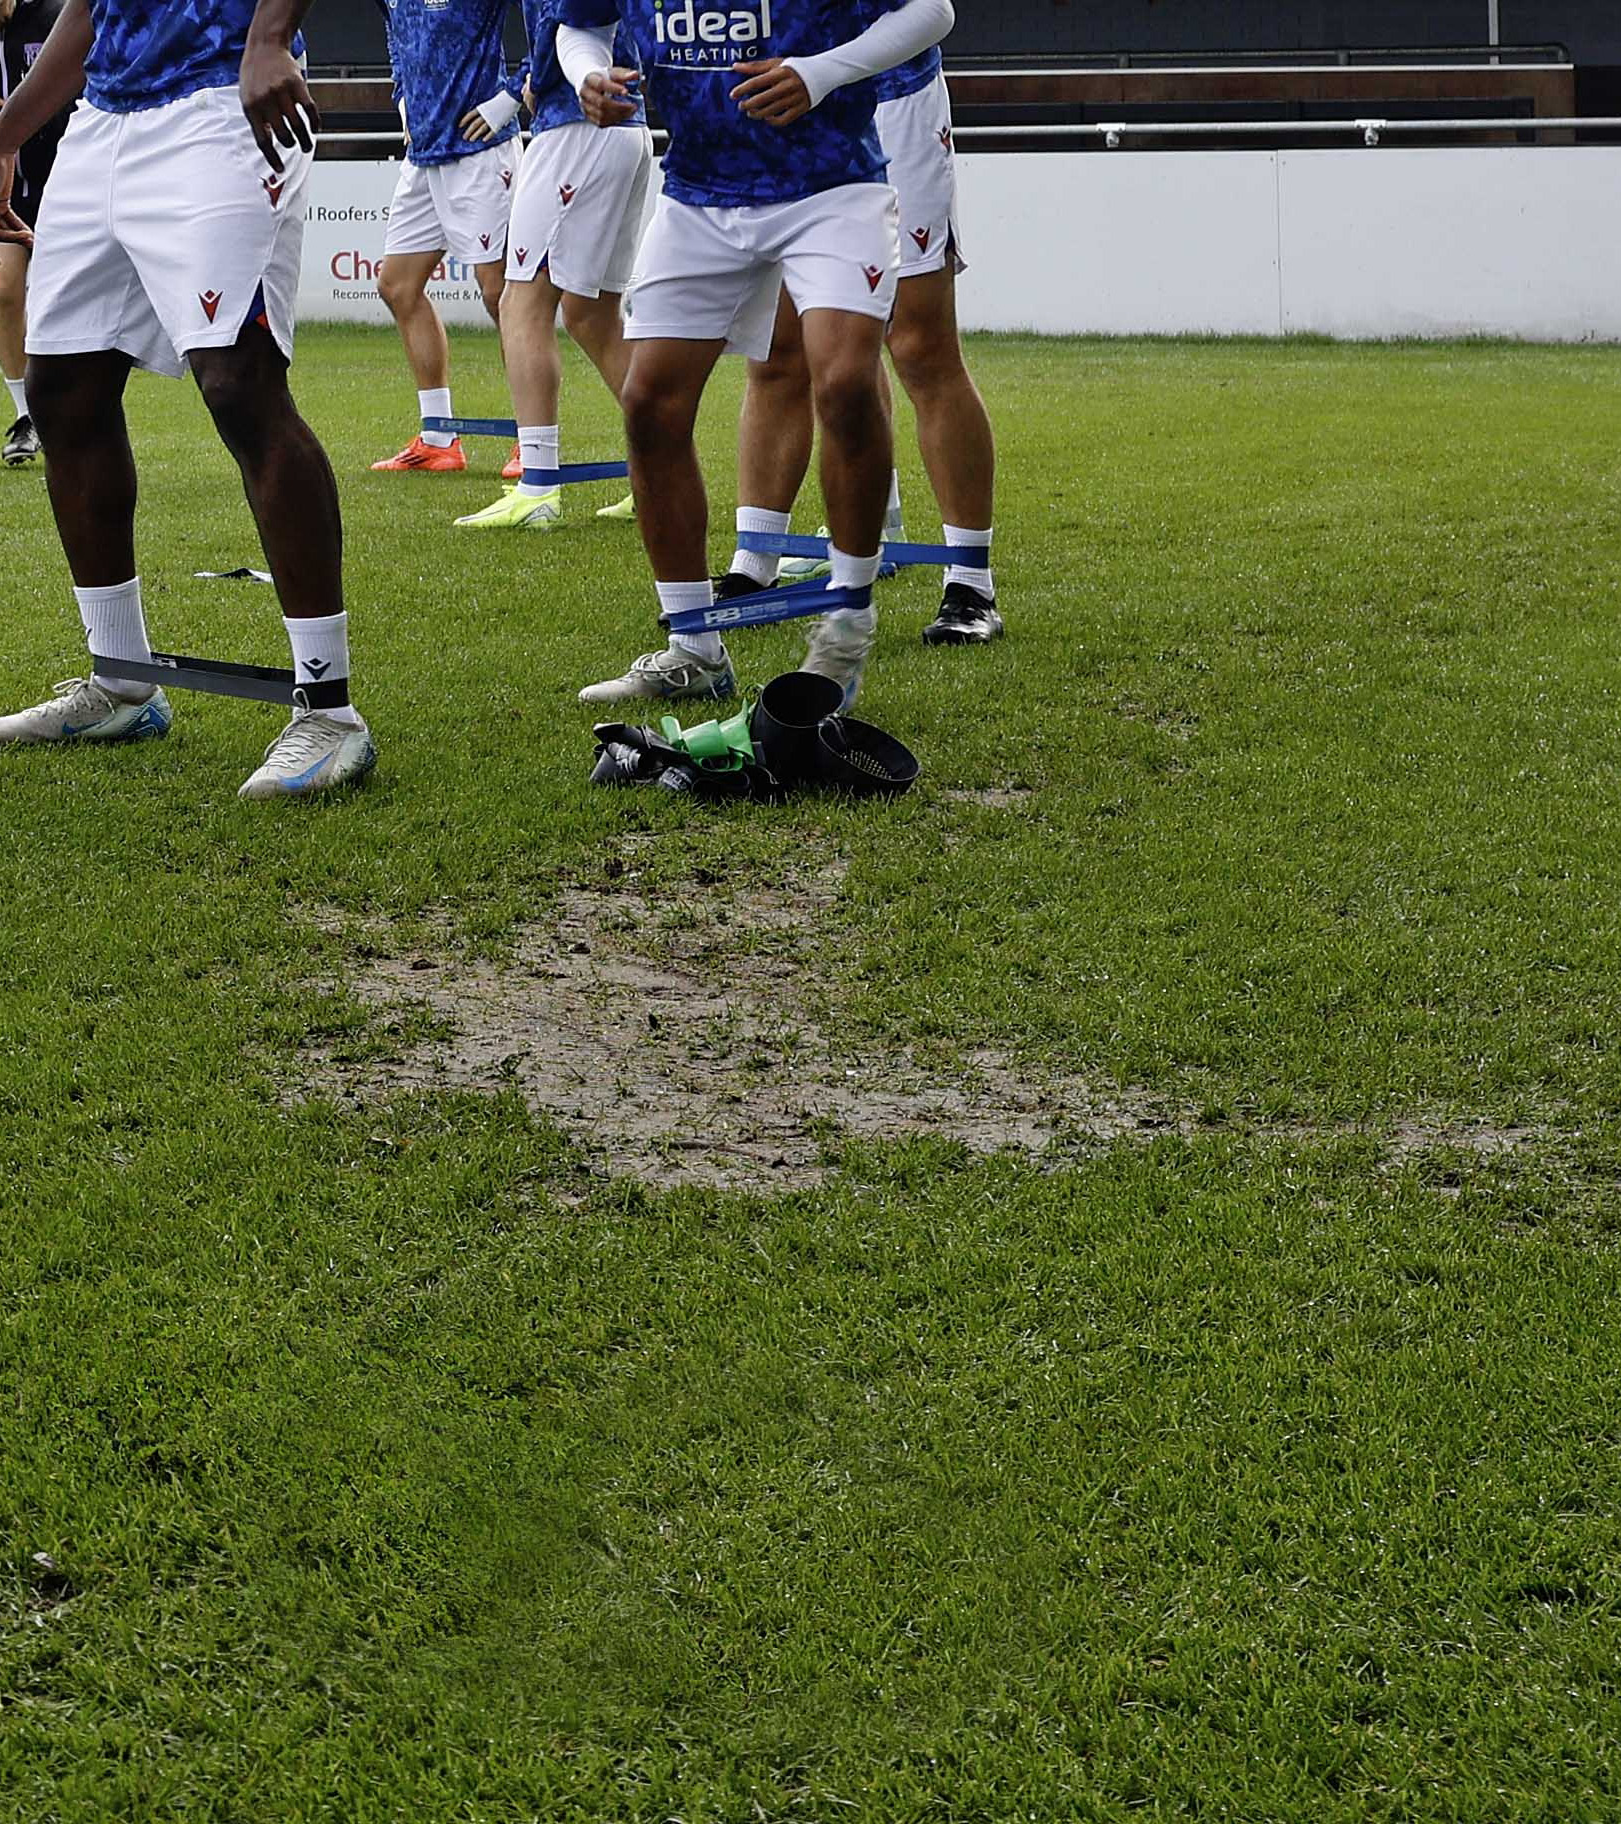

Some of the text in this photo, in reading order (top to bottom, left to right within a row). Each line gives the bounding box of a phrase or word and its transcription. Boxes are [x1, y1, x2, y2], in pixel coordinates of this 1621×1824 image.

[670, 46, 758, 61] HEATING
[317, 207, 378, 221] Roofers
[463, 290, 471, 300] &
